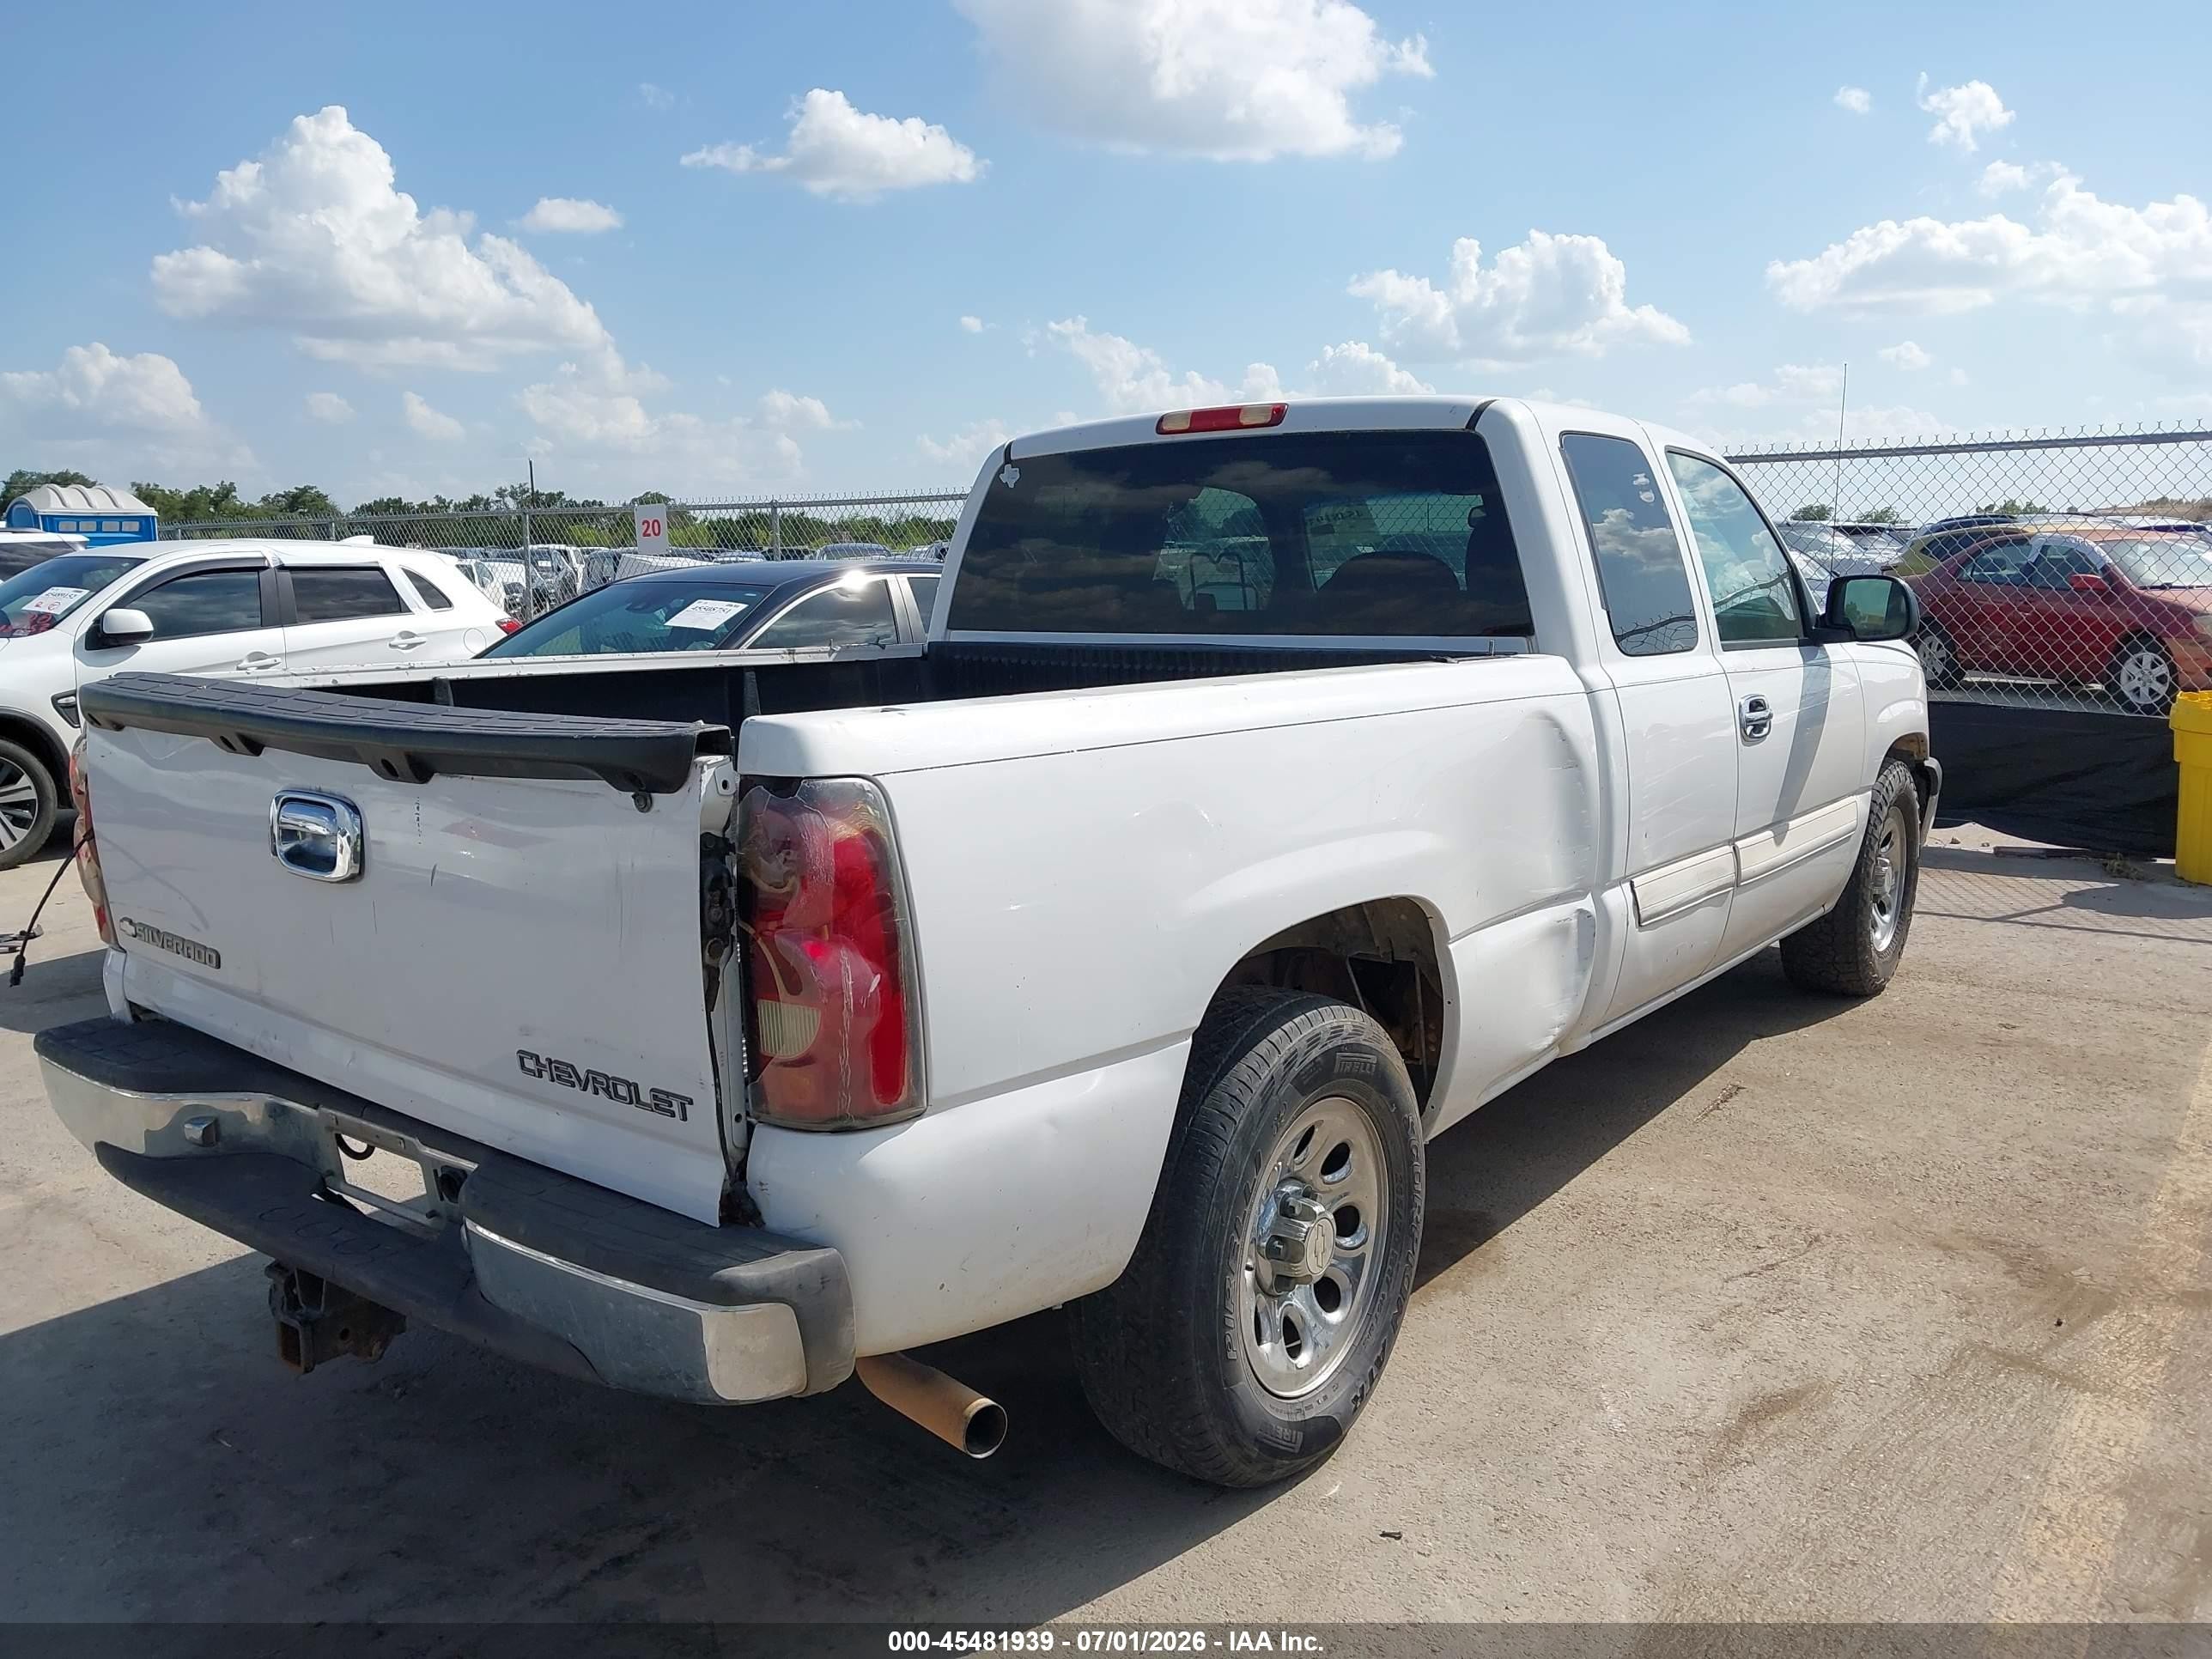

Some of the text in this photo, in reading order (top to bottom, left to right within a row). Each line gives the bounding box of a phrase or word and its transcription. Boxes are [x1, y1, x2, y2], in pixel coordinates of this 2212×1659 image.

[642, 519, 661, 537] 20
[137, 922, 221, 969] SILVERADO
[1334, 1052, 1377, 1073] PIRELLI
[516, 1049, 694, 1121] CHEVROLET
[1224, 1148, 1262, 1360] PIRELLI
[1256, 1424, 1304, 1454] PIRE
